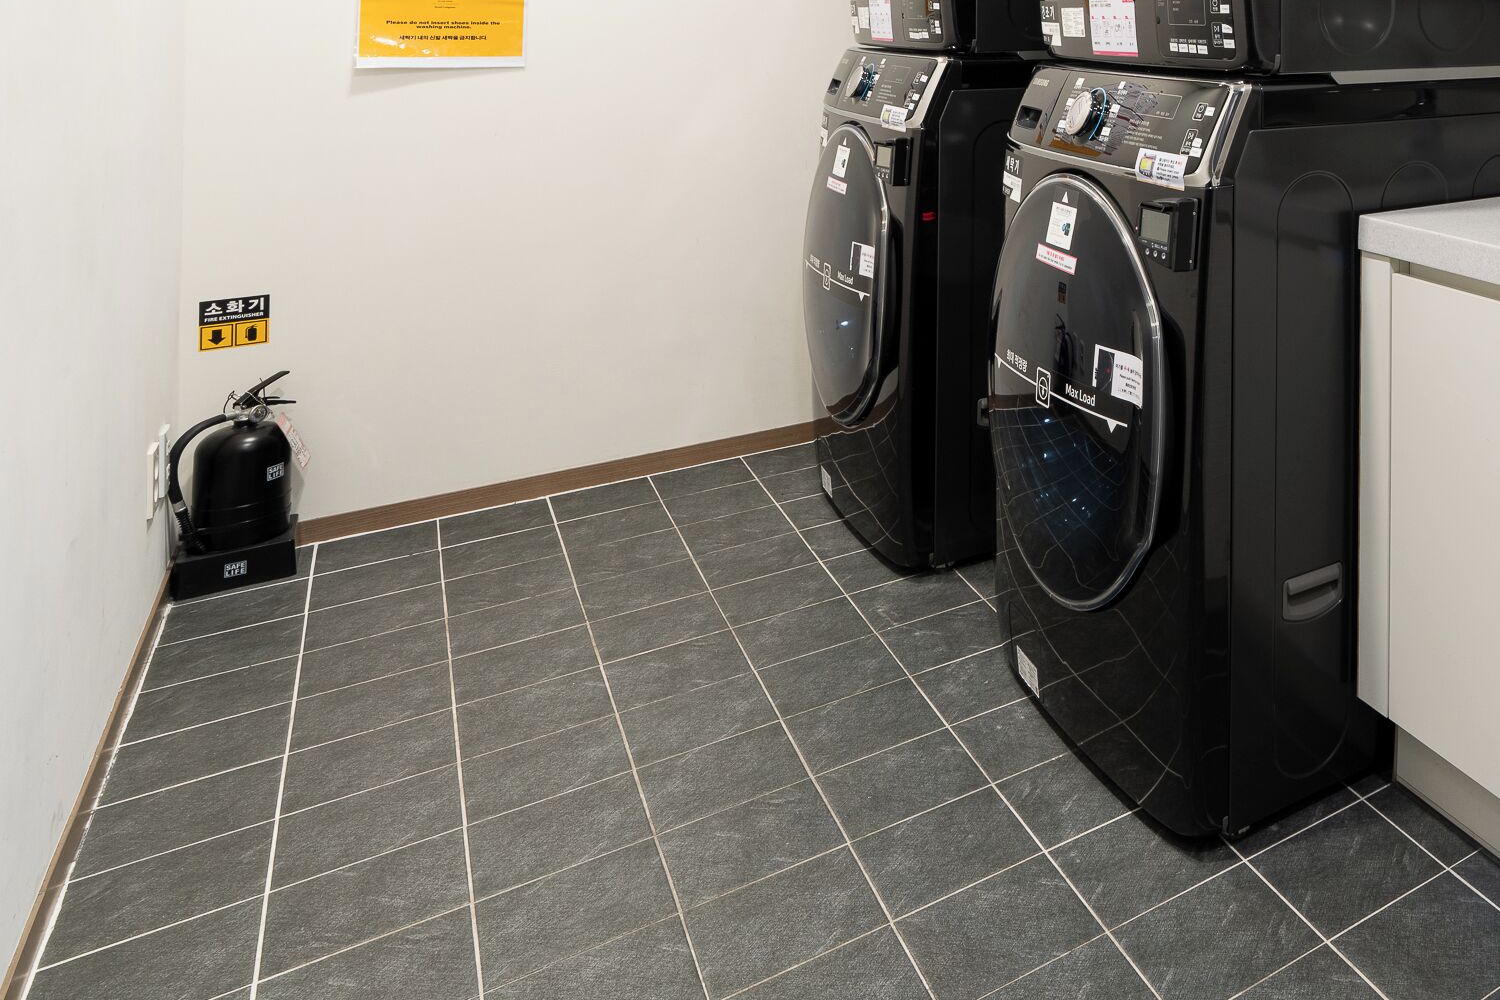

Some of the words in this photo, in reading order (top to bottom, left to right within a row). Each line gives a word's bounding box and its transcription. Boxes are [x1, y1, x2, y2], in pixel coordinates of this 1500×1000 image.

[204, 297, 264, 316] 소화기
[219, 312, 264, 321] EXTINGUISHER
[1065, 383, 1079, 400] Max
[1079, 390, 1096, 406] Load
[268, 464, 283, 474] SAFE
[268, 472, 283, 481] LIFE
[226, 561, 246, 570] SAFE
[226, 568, 246, 577] LIFE
